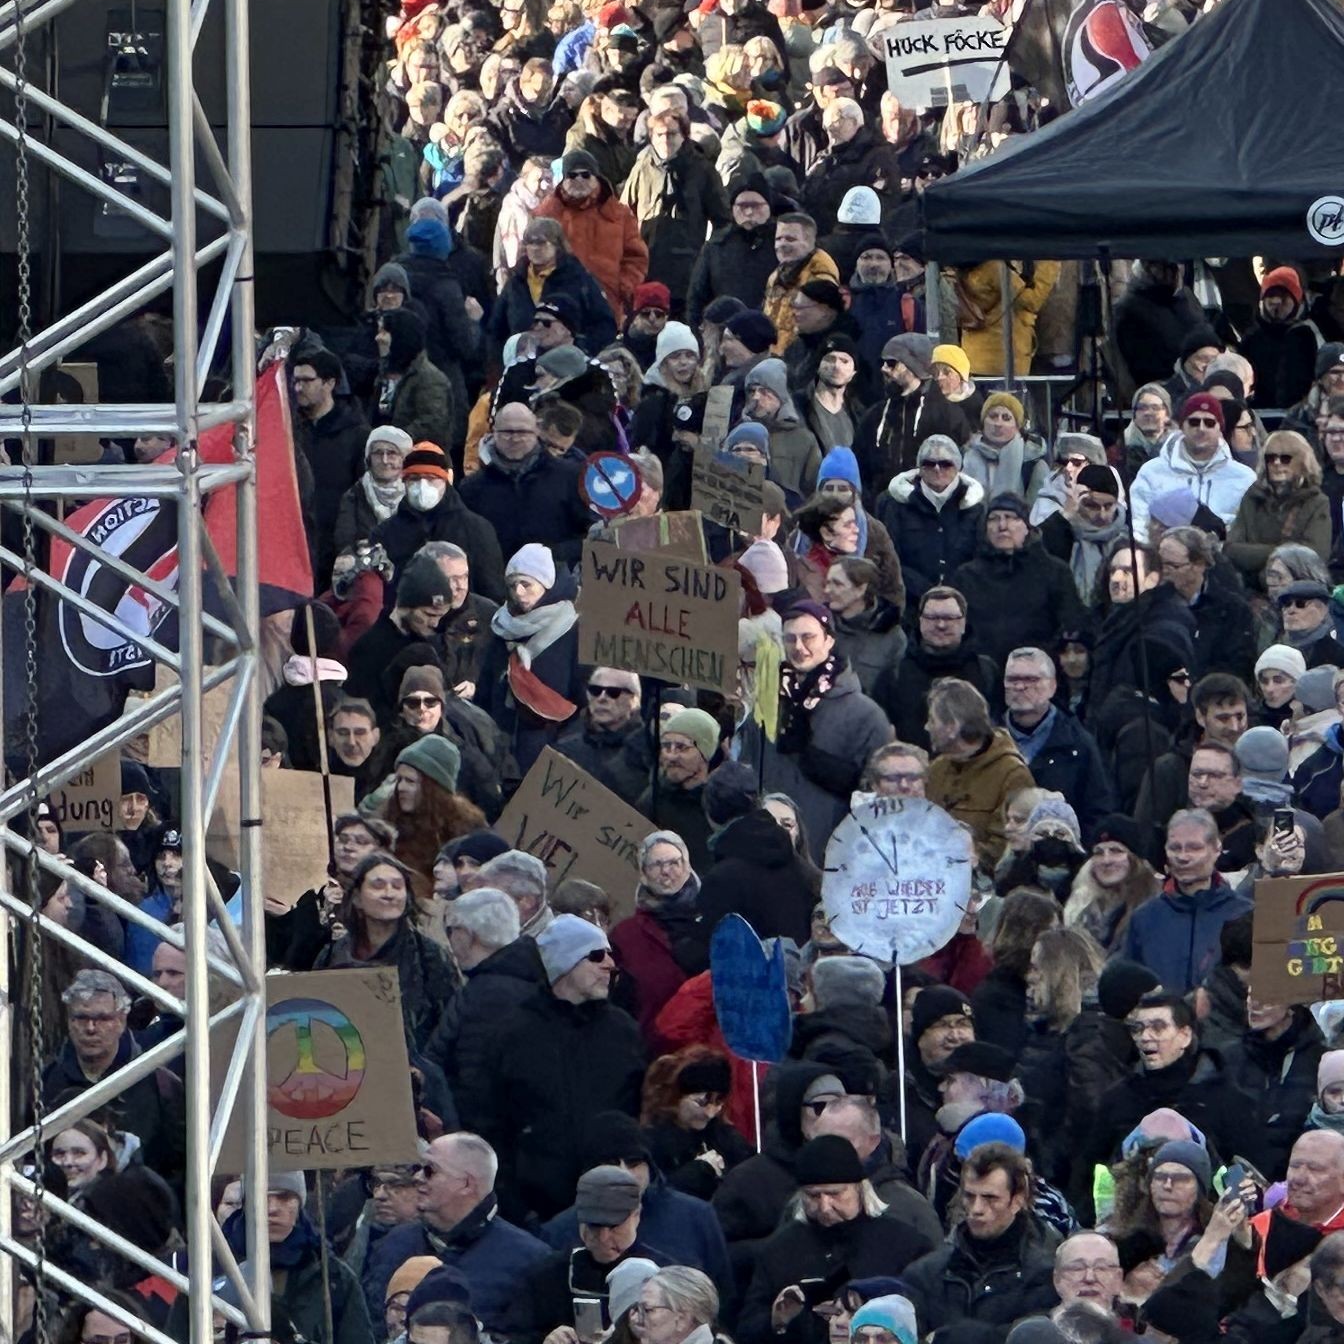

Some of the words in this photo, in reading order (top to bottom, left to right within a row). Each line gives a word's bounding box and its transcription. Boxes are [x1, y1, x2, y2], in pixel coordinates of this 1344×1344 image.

[591, 551, 646, 590] WIR
[664, 565, 727, 602] SIND
[624, 600, 692, 640] ALLE
[593, 631, 724, 687] MENSCHEN
[541, 759, 590, 820] Wir
[595, 820, 640, 871] sin
[267, 1120, 370, 1156] PEACE
